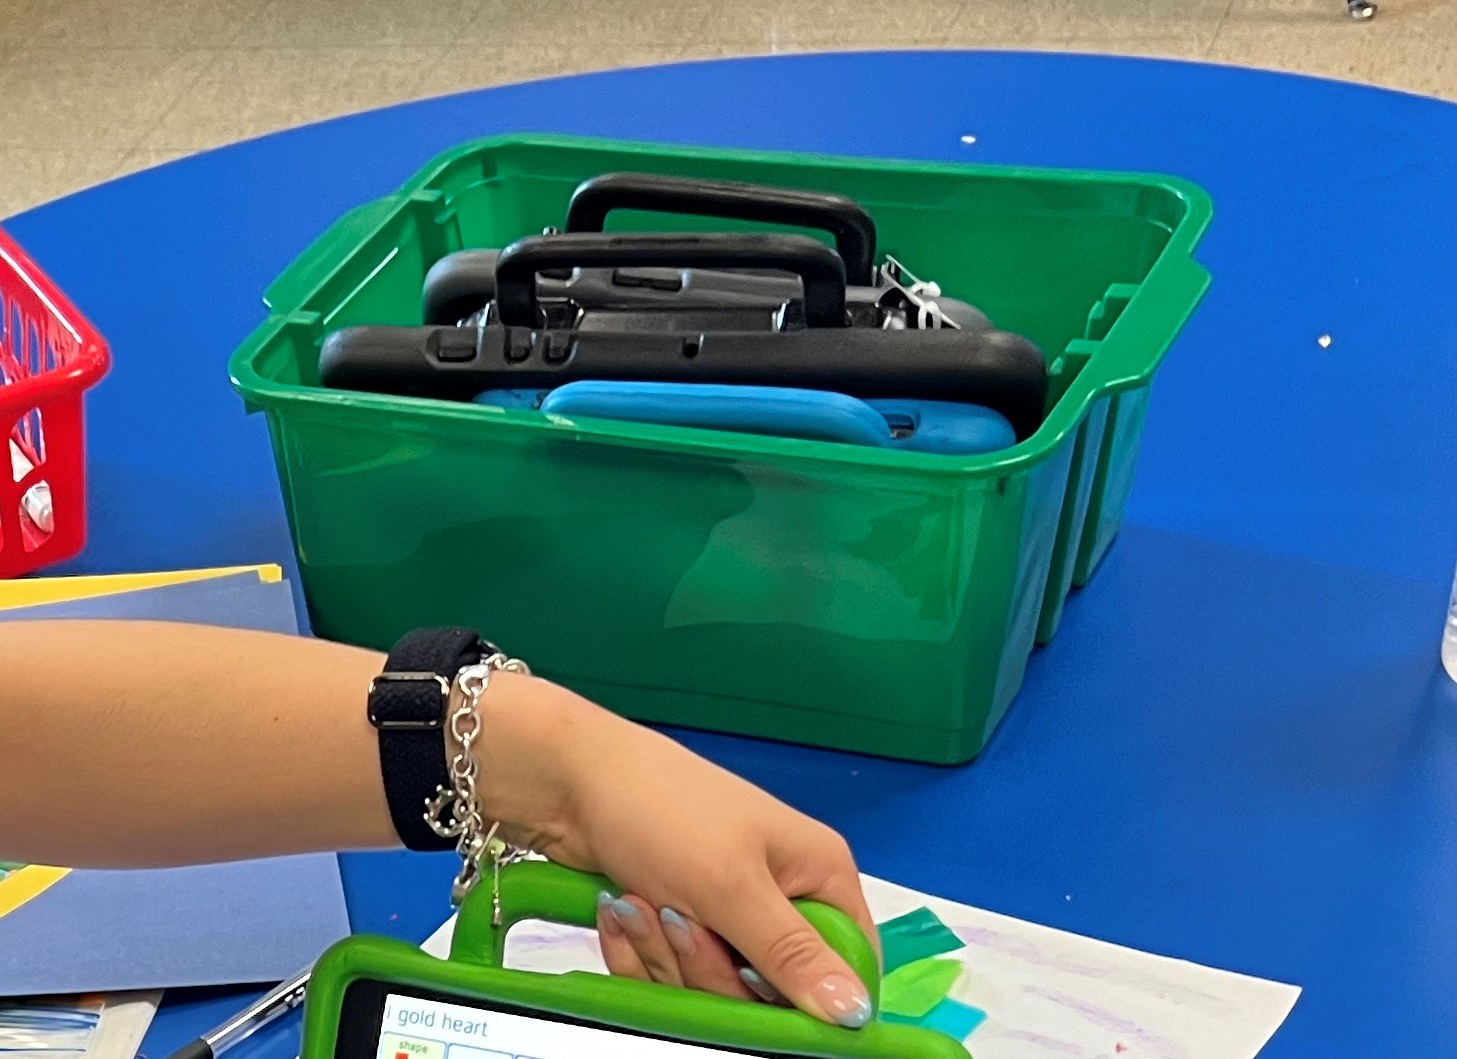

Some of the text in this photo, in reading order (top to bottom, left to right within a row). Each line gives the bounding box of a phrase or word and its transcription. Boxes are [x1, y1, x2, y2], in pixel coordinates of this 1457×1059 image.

[398, 1007, 488, 1037] gold heart
[398, 1040, 428, 1054] shape
